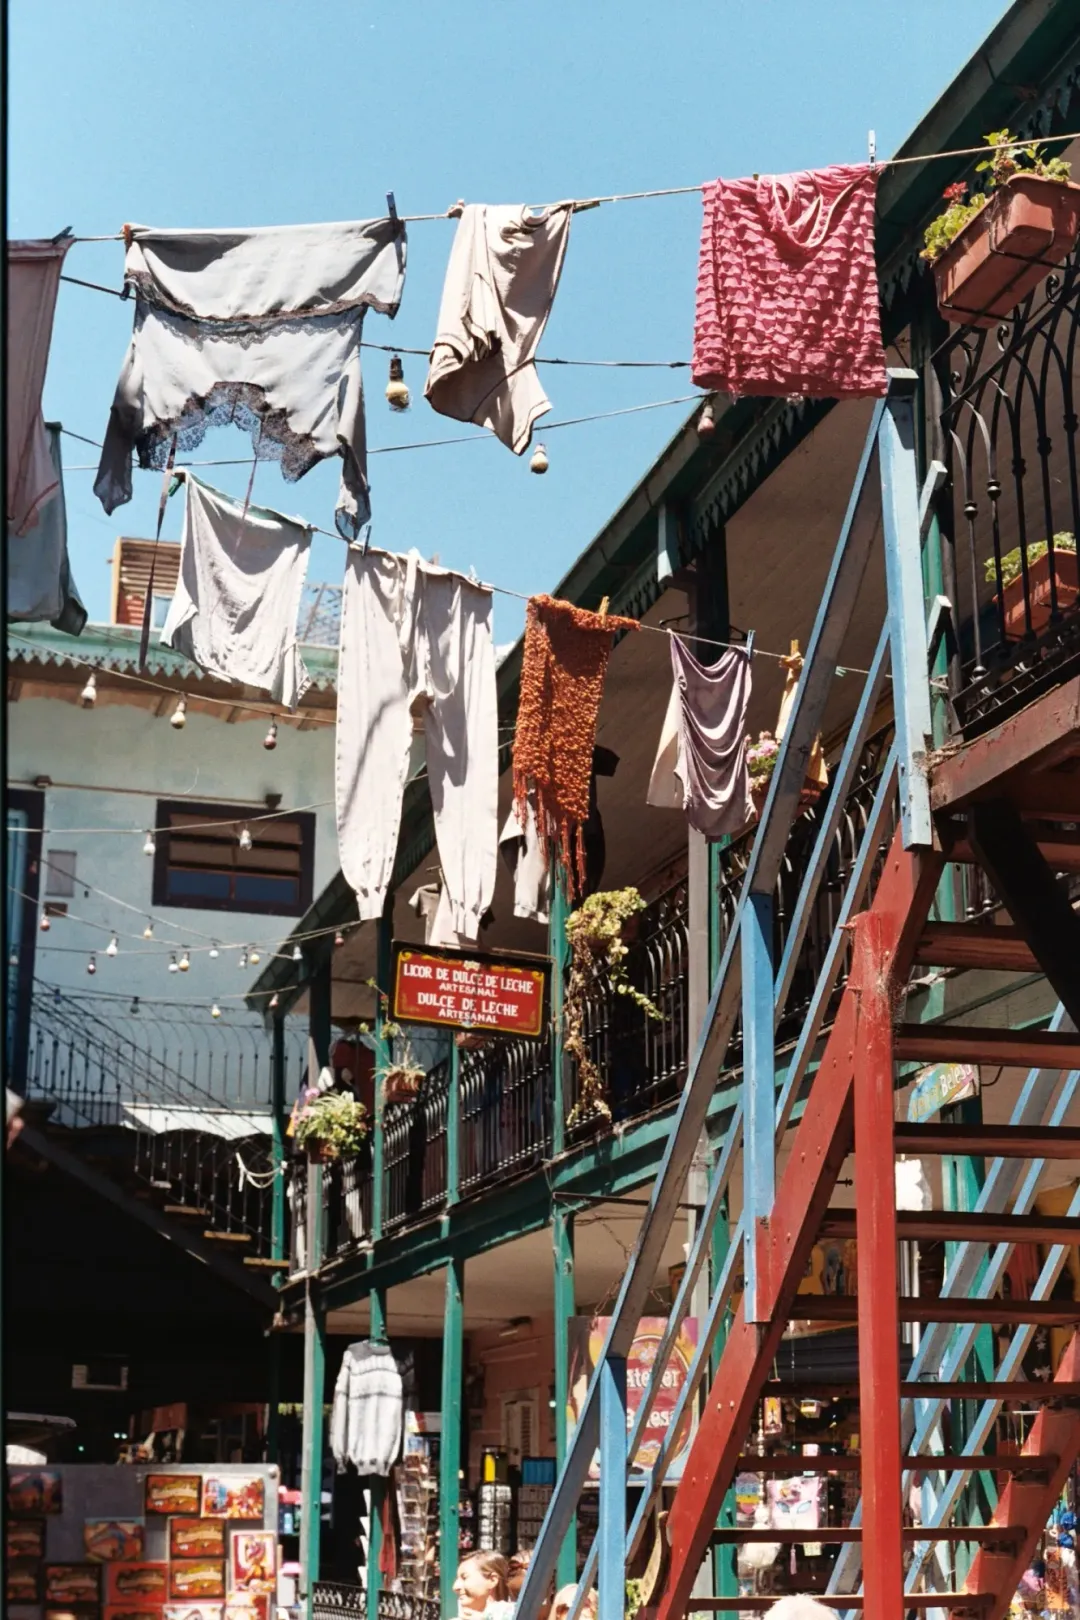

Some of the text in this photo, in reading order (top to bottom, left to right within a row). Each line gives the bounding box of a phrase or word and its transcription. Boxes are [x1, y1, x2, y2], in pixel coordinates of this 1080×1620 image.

[403, 963, 534, 994] LICOR DE DULCE DE LECHE
[439, 982, 498, 997] ARTESANAL
[417, 992, 519, 1017] DULCE DE LECHE
[438, 1008, 498, 1023] ARTESANAL
